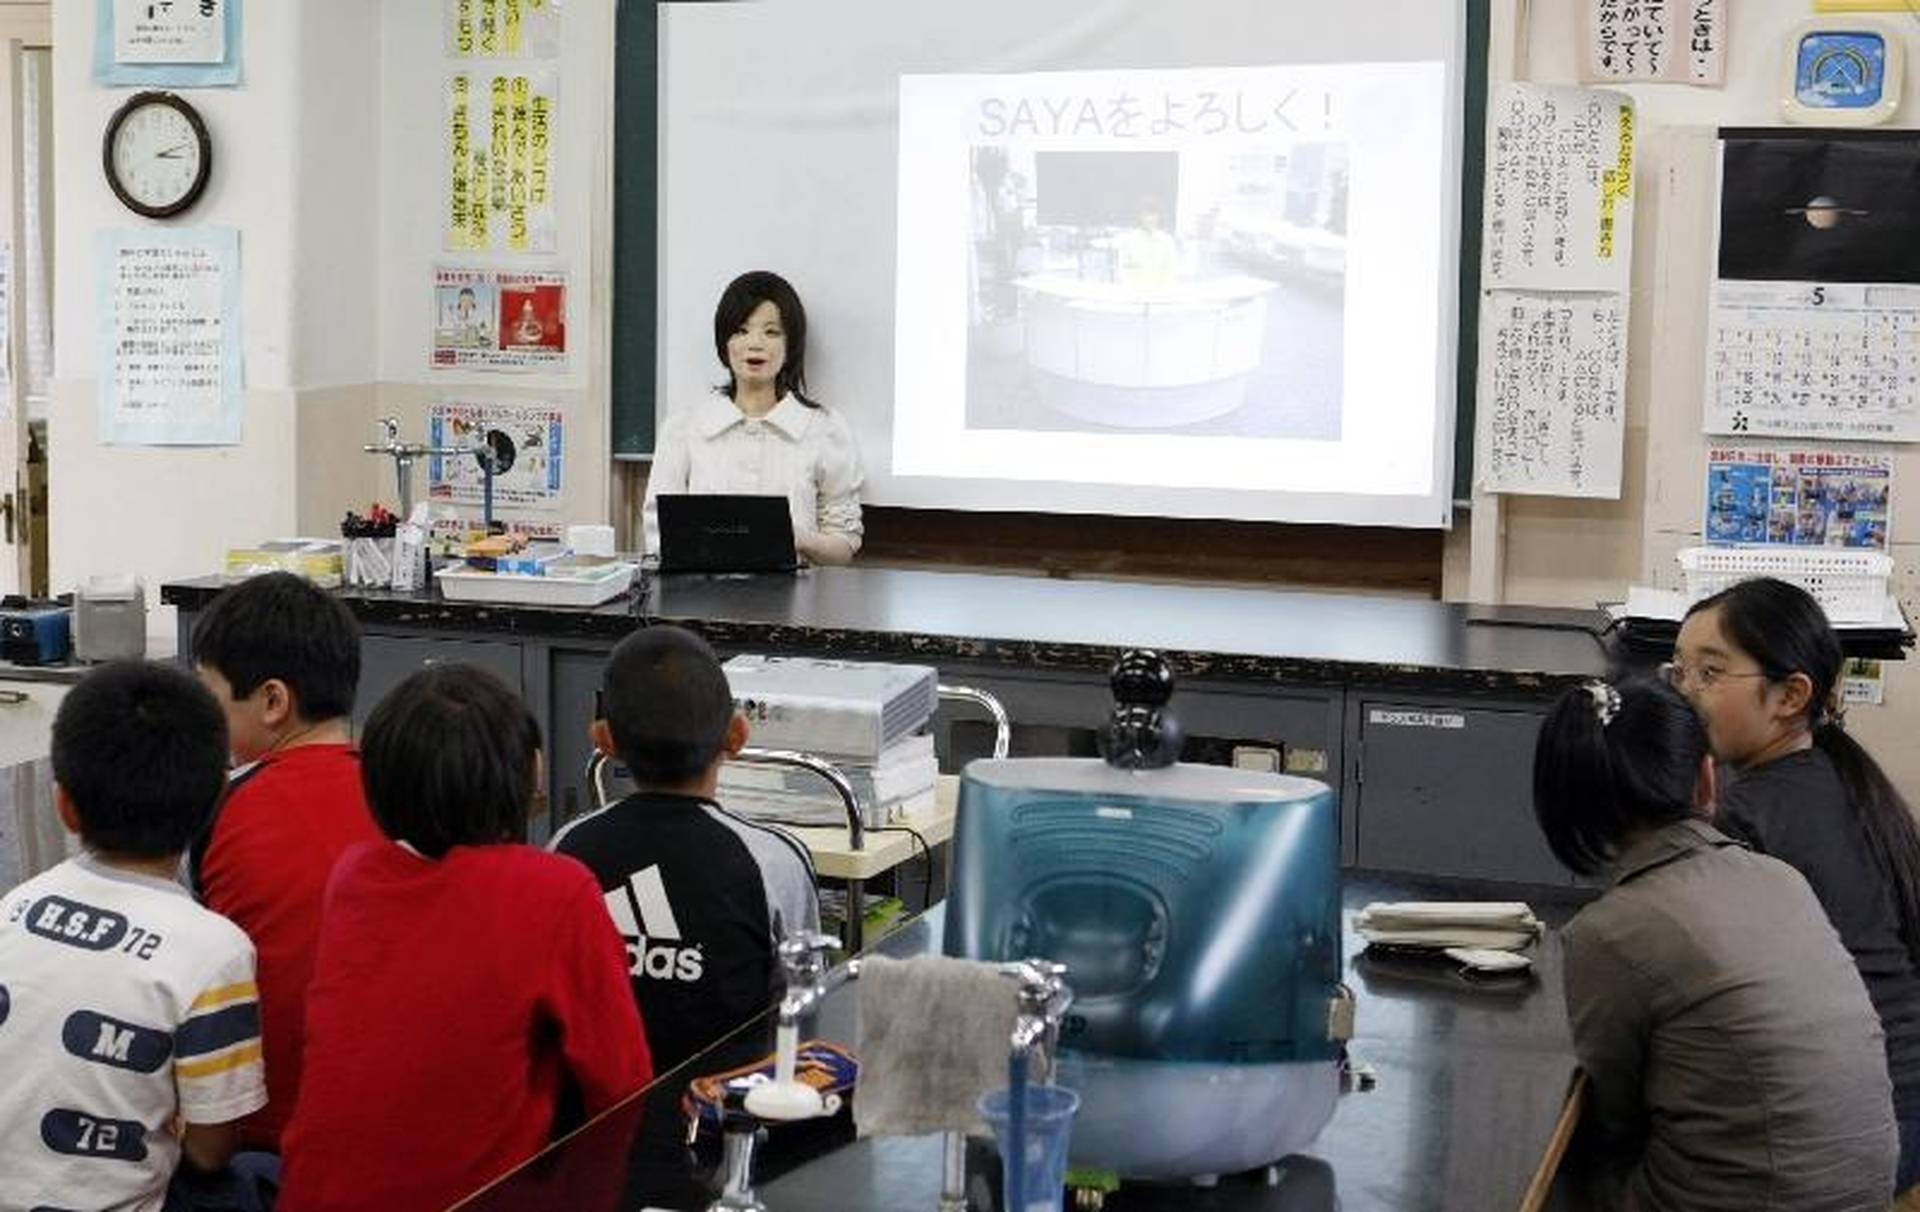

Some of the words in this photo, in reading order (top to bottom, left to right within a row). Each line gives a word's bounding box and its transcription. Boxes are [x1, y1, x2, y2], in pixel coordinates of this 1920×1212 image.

[1811, 287, 1825, 306] 5
[37, 903, 117, 943] H.S.F
[123, 928, 162, 960] 72
[92, 1022, 135, 1062] M
[76, 1118, 119, 1151] 72
